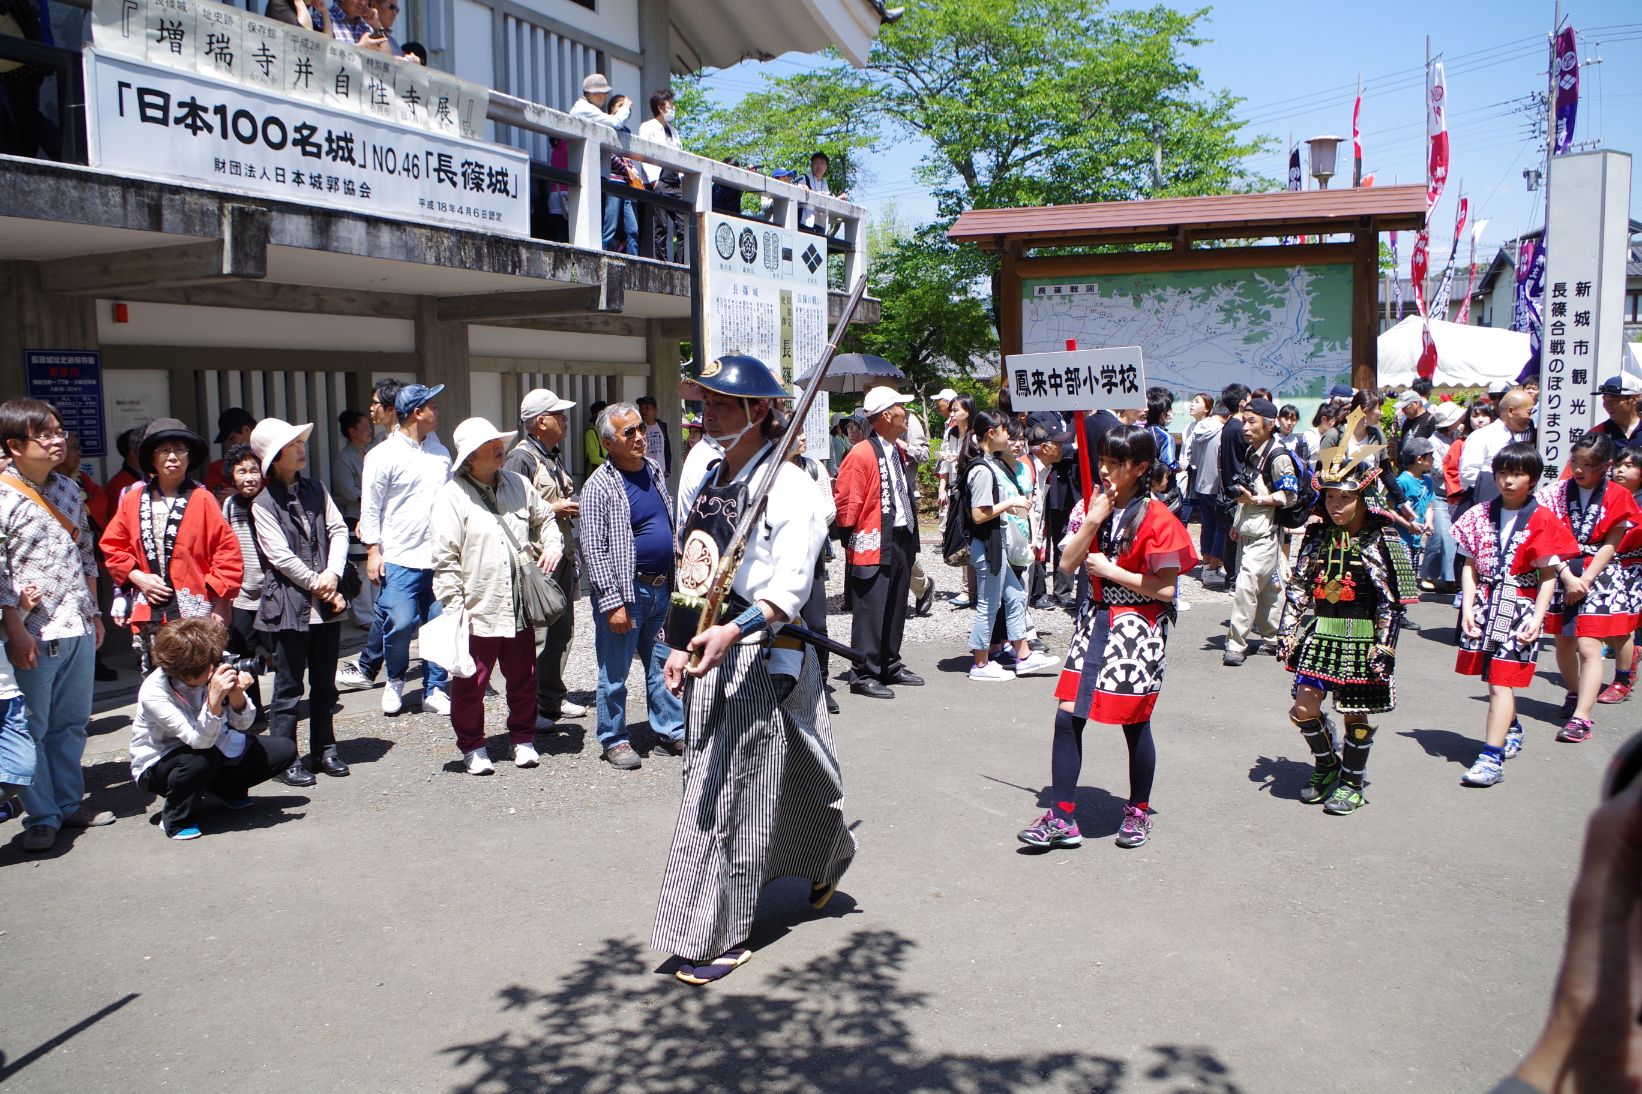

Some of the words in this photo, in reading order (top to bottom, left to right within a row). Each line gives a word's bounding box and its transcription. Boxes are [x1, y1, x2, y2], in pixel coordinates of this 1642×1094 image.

[214, 157, 372, 198] 財団法人日本城郭協会
[1015, 363, 1139, 398] 鳳来中部小学校
[1543, 282, 1567, 487] 長篠合戦のぼりまつり奉
